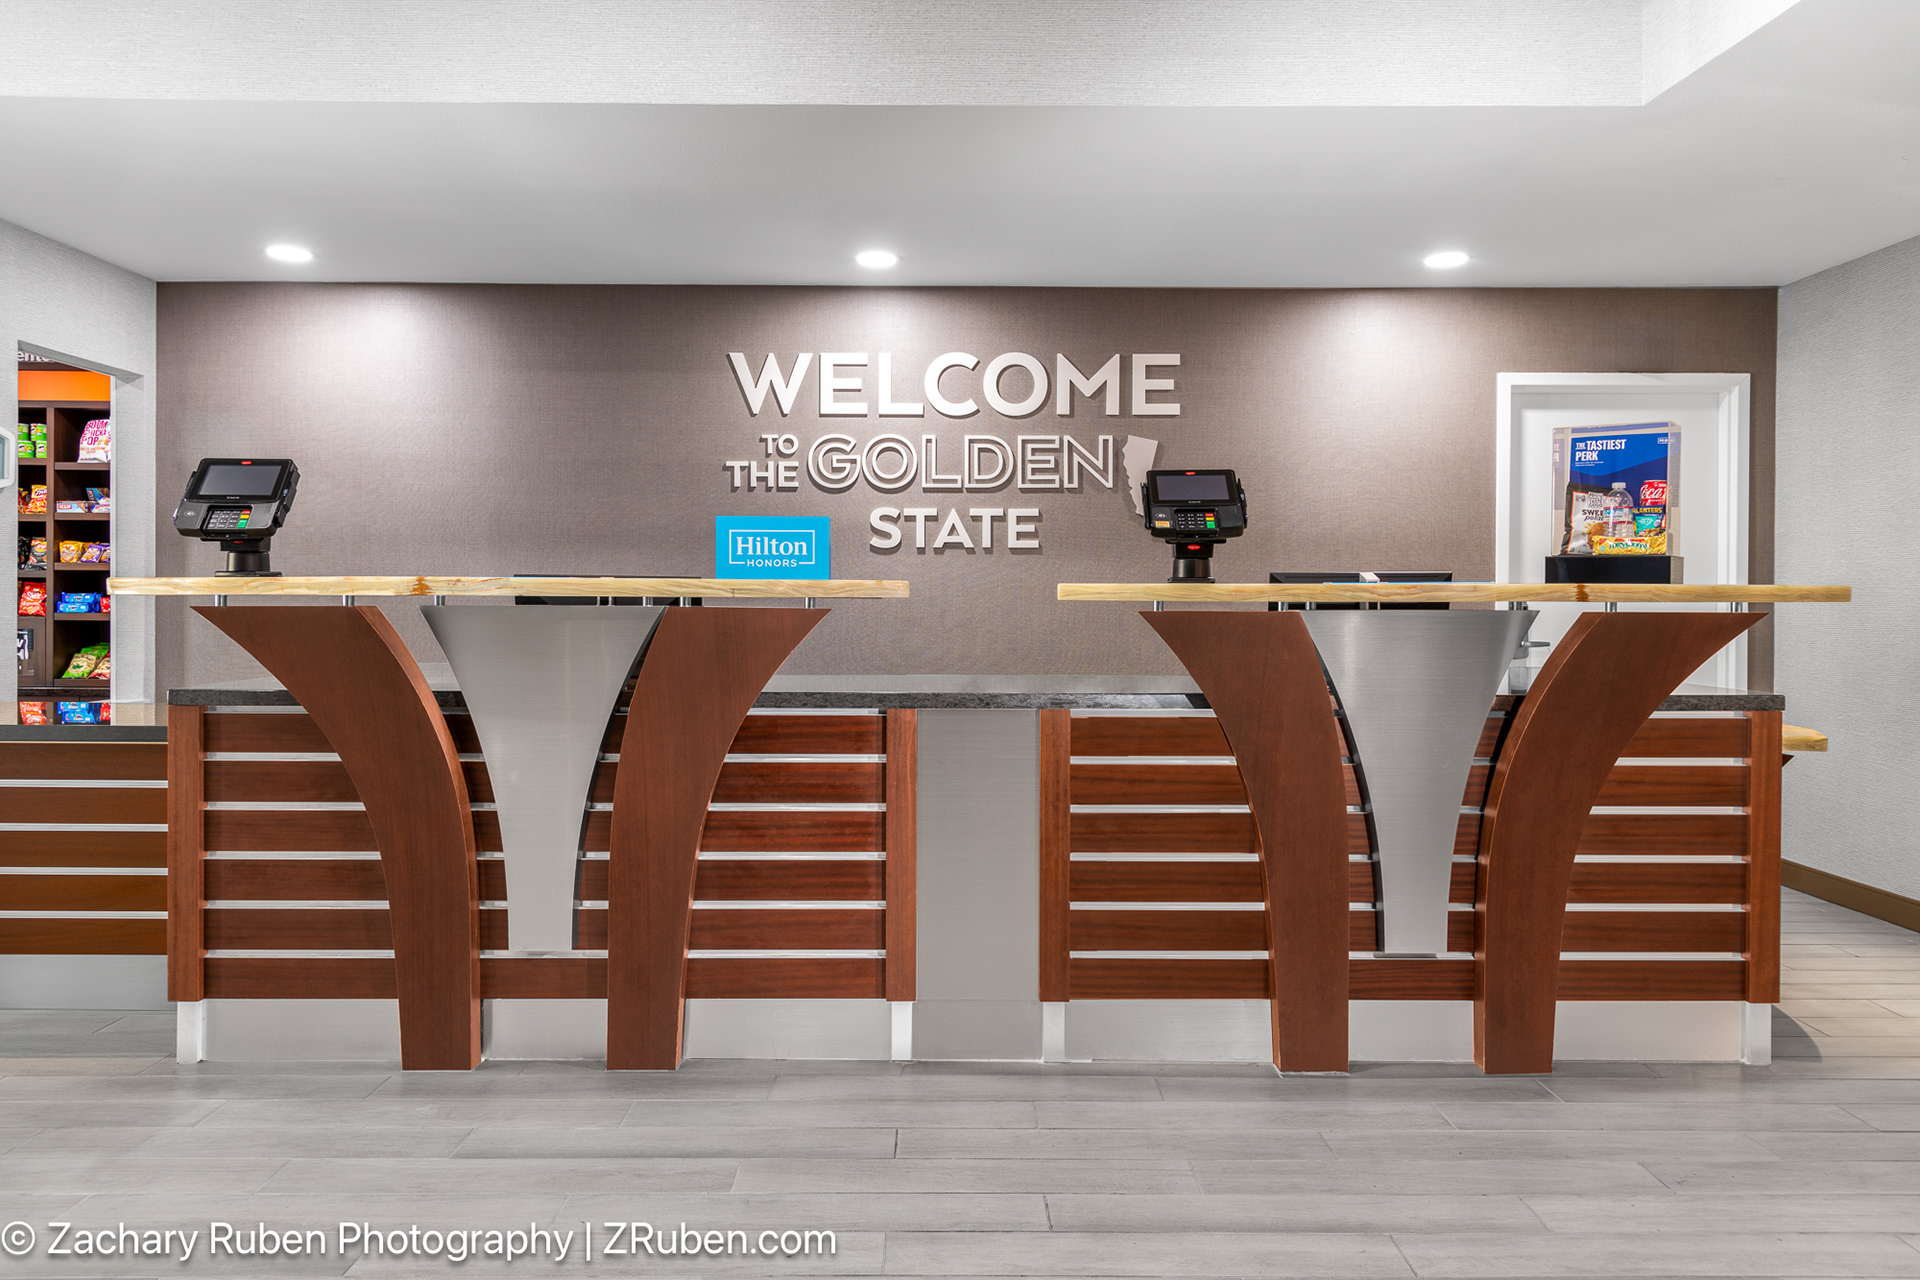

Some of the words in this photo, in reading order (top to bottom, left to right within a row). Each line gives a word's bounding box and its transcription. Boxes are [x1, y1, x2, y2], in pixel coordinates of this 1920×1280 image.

[728, 352, 1181, 416] WELCOME
[761, 433, 799, 456] TO
[1575, 442, 1586, 450] THE
[1586, 439, 1627, 451] TASTIEST
[725, 461, 800, 488] THE
[807, 433, 1114, 489] GOLDEN
[1575, 450, 1599, 462] PERK
[1581, 508, 1604, 516] SWEE
[869, 507, 1040, 549] STATE
[736, 536, 808, 556] Hilton
[746, 559, 798, 568] HONORS
